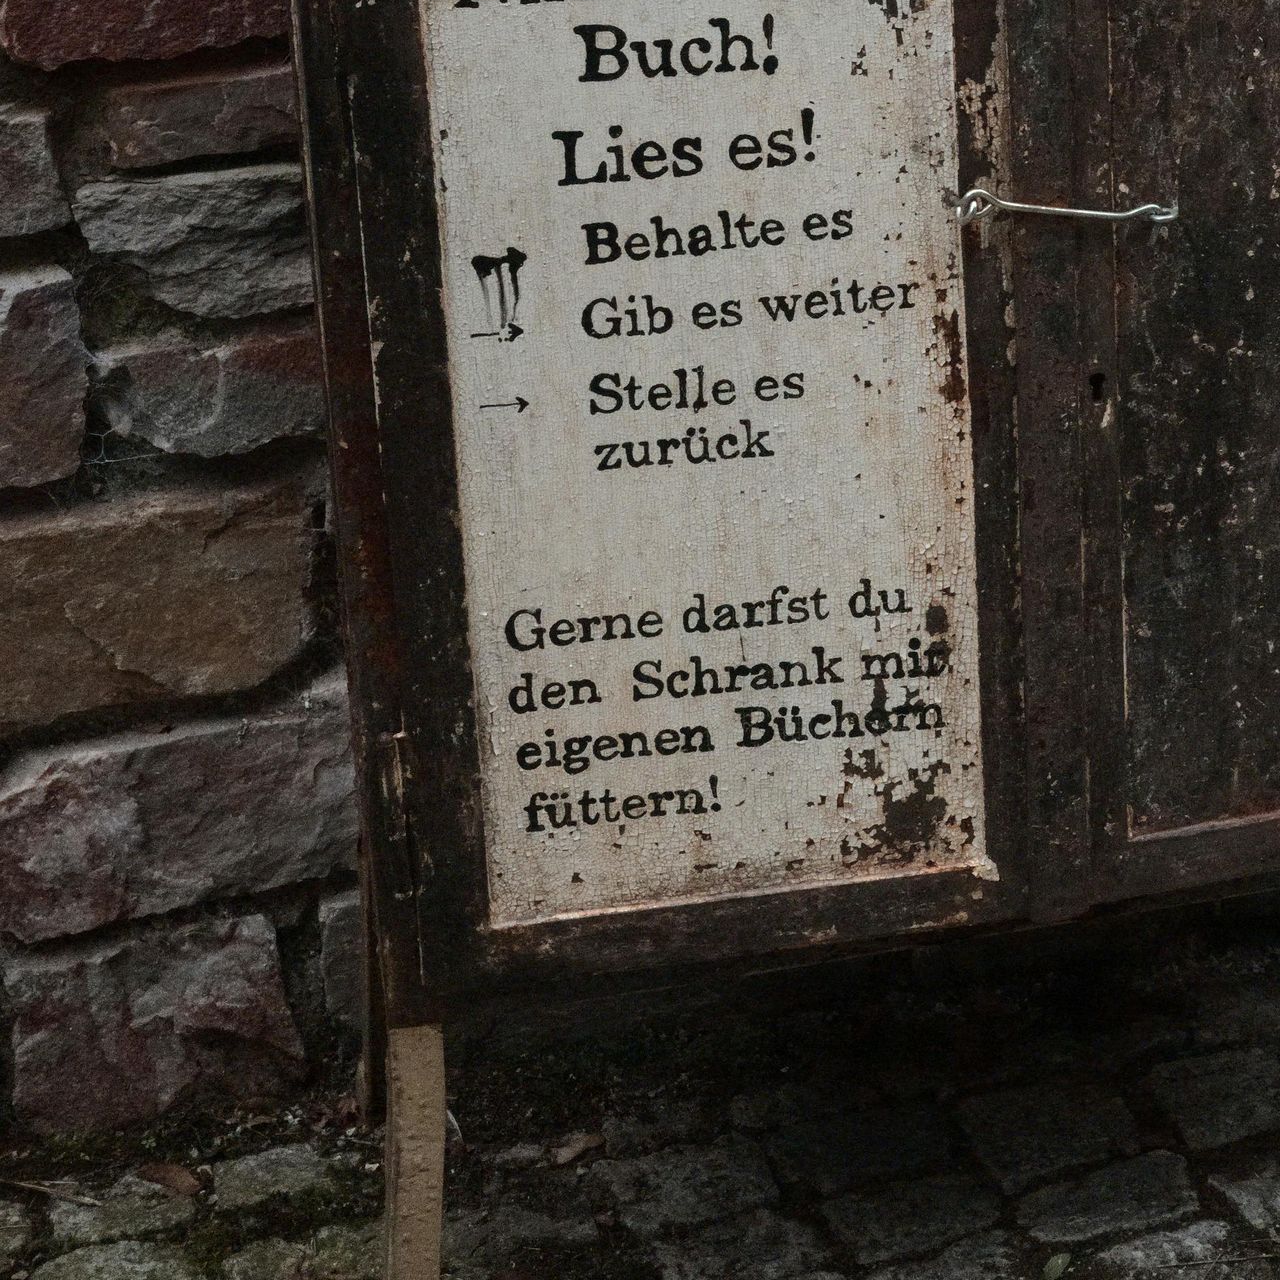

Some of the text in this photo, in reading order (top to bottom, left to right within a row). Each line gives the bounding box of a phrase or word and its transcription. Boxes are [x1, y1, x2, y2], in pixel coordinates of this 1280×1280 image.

[574, 15, 781, 82] Buch!
[552, 109, 819, 186] Lies es!
[582, 208, 853, 265] Behalte es
[581, 276, 922, 338] Gib es weiter
[589, 365, 805, 414] Stelle es
[595, 421, 775, 471] zurück
[505, 578, 912, 651] Gerne darfst du
[508, 640, 951, 714] den Schrank mit
[517, 701, 946, 775] eigenen Büchern
[523, 775, 724, 833] füttern!
